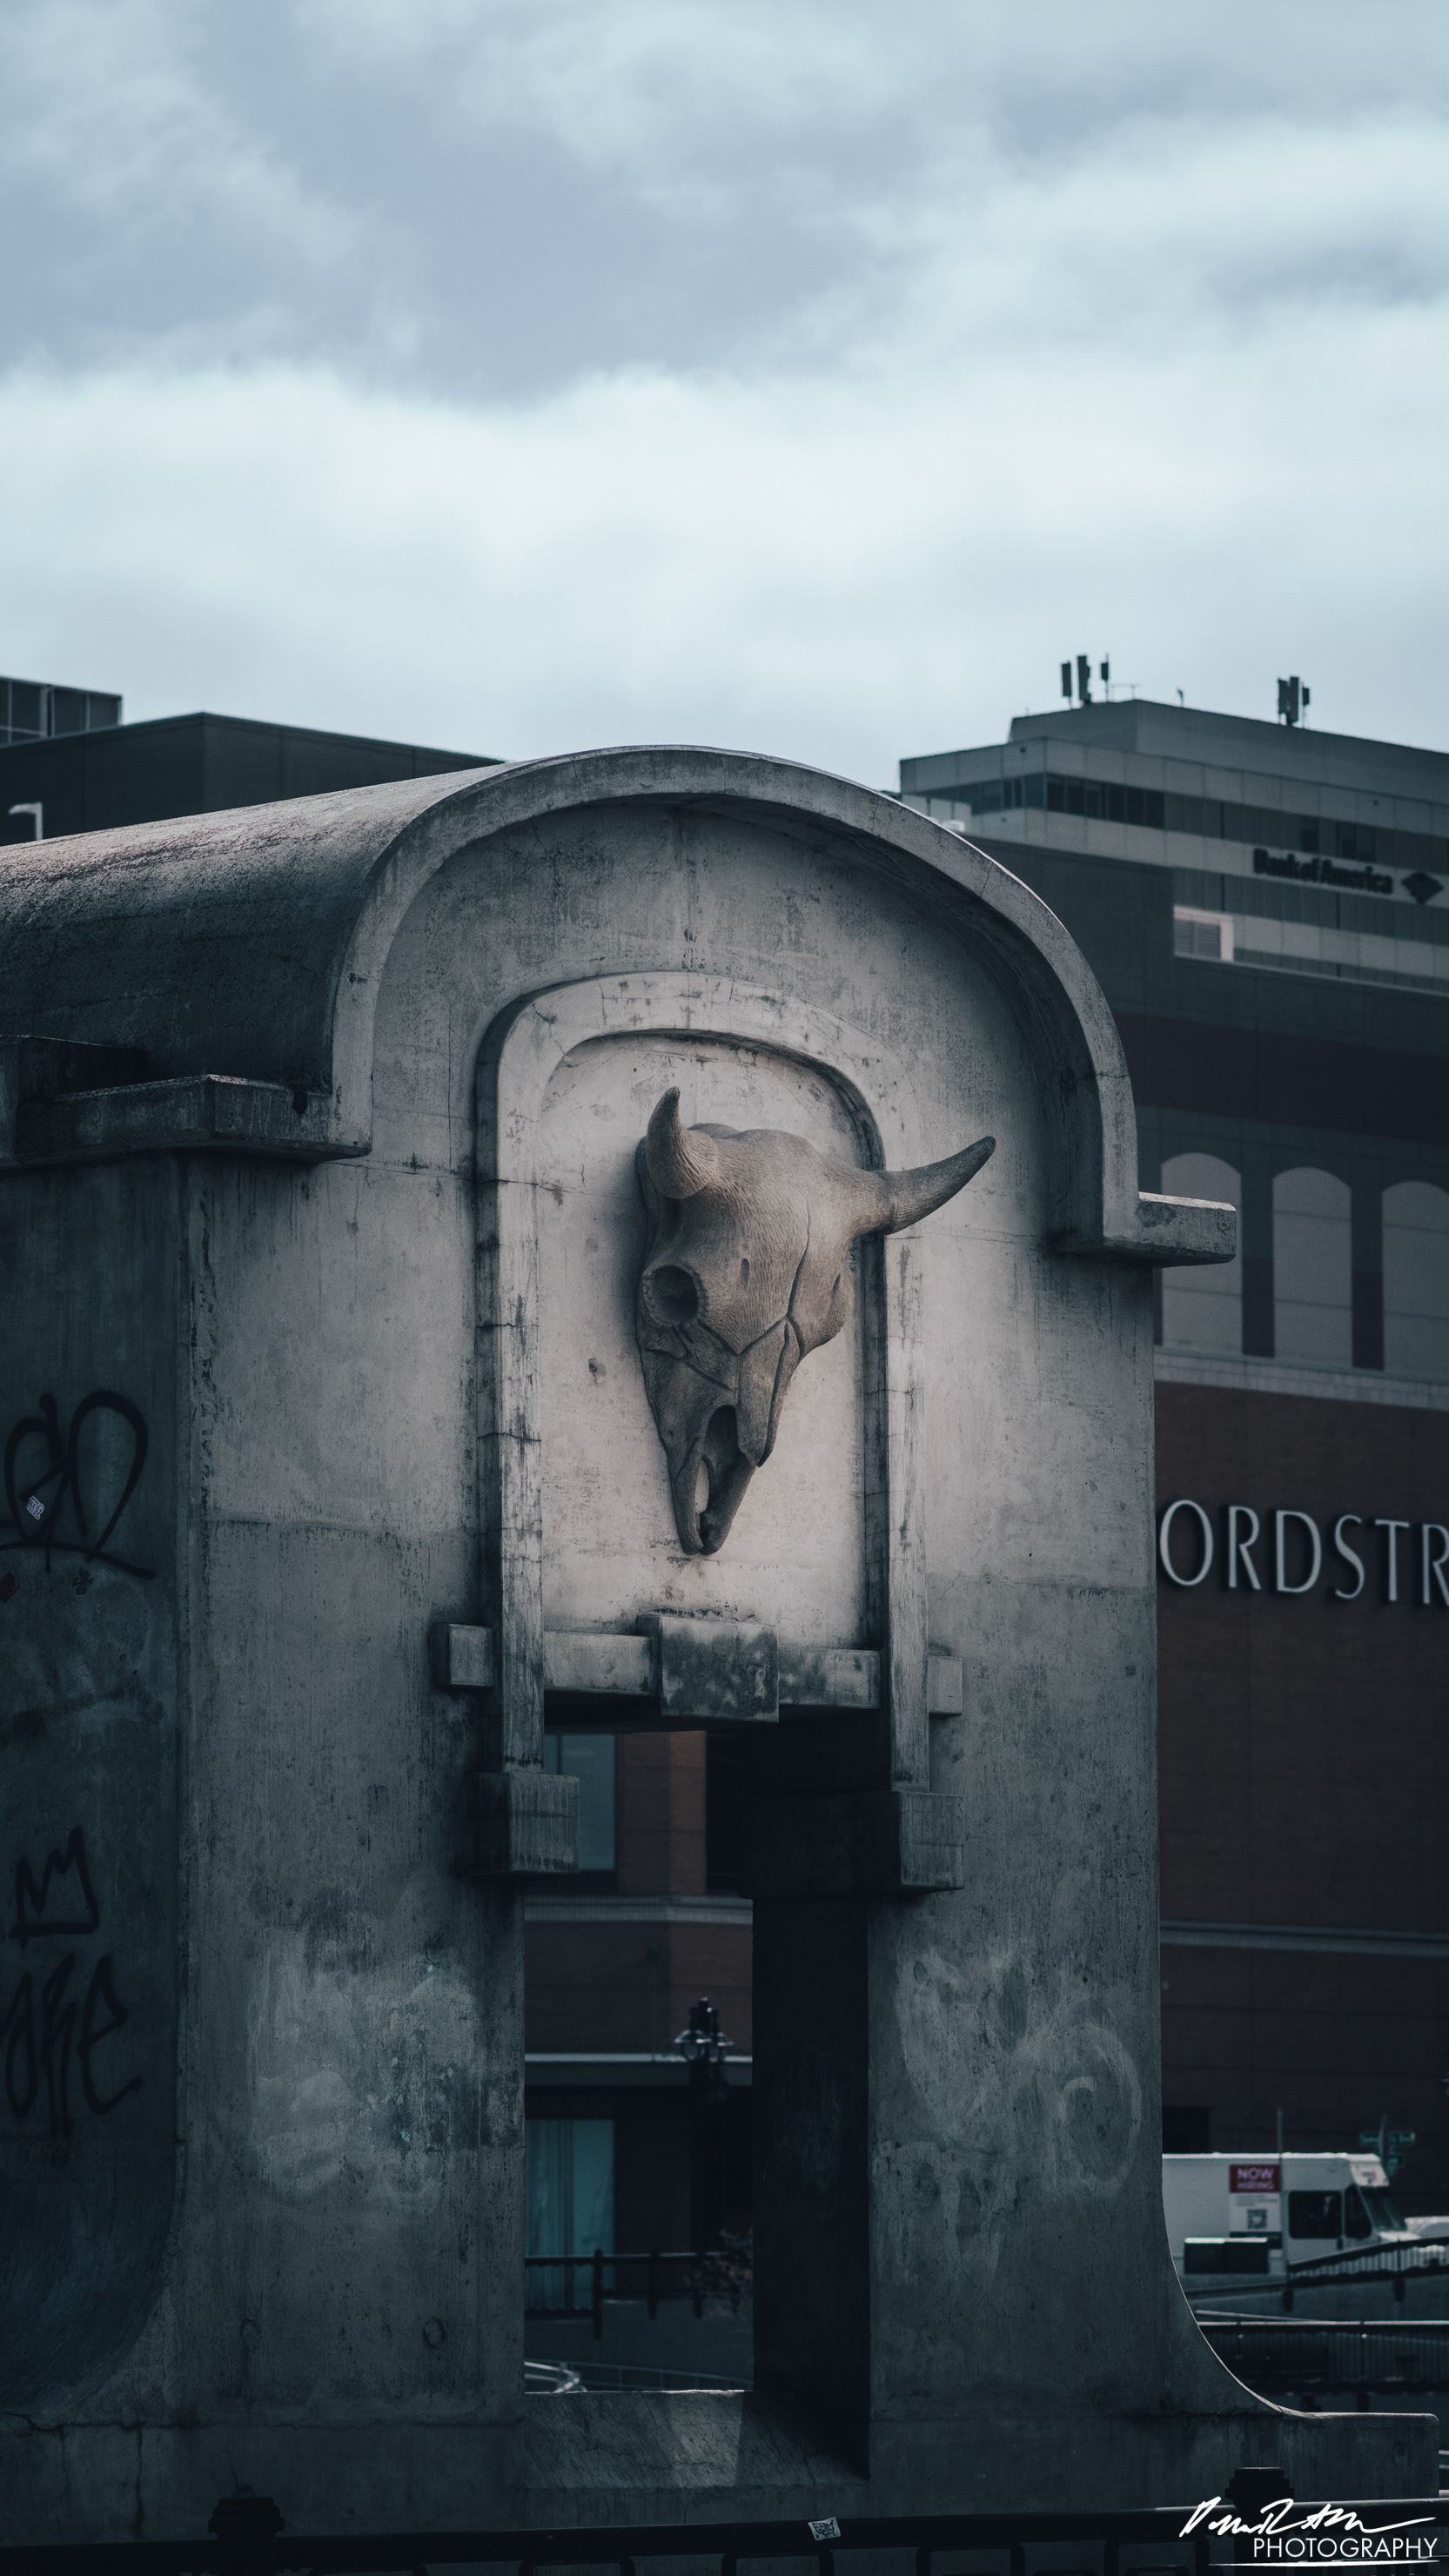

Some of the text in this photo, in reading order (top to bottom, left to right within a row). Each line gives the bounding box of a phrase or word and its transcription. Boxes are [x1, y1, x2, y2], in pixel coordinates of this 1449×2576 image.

[1253, 848, 1392, 895] Bank of America
[1237, 2167, 1275, 2180] NOW
